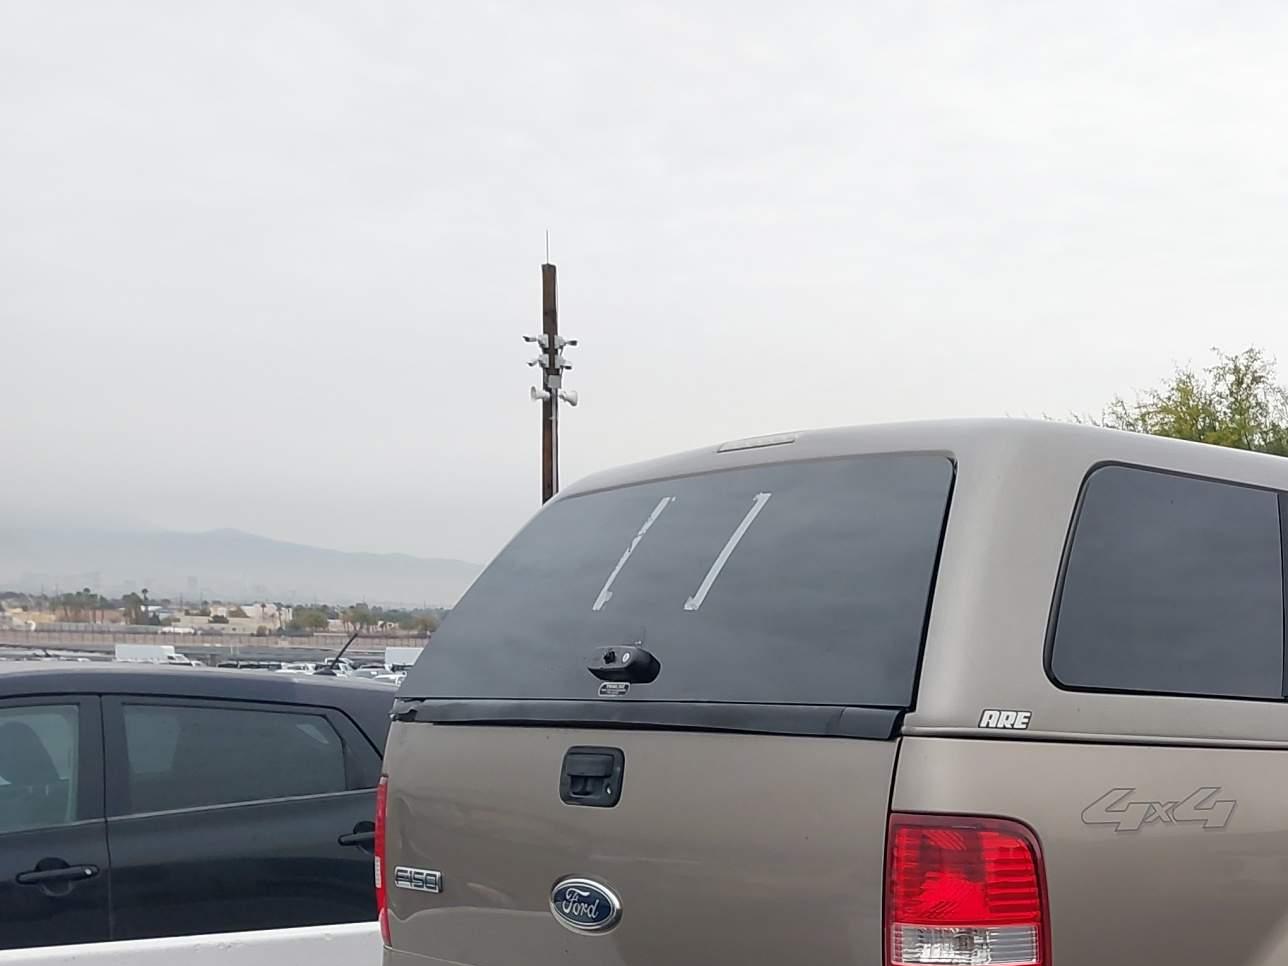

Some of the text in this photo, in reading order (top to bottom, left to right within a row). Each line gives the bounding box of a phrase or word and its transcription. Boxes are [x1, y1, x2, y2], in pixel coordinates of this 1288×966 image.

[979, 709, 1032, 729] ARE
[1081, 786, 1237, 832] 4x4
[562, 887, 600, 919] Ford
